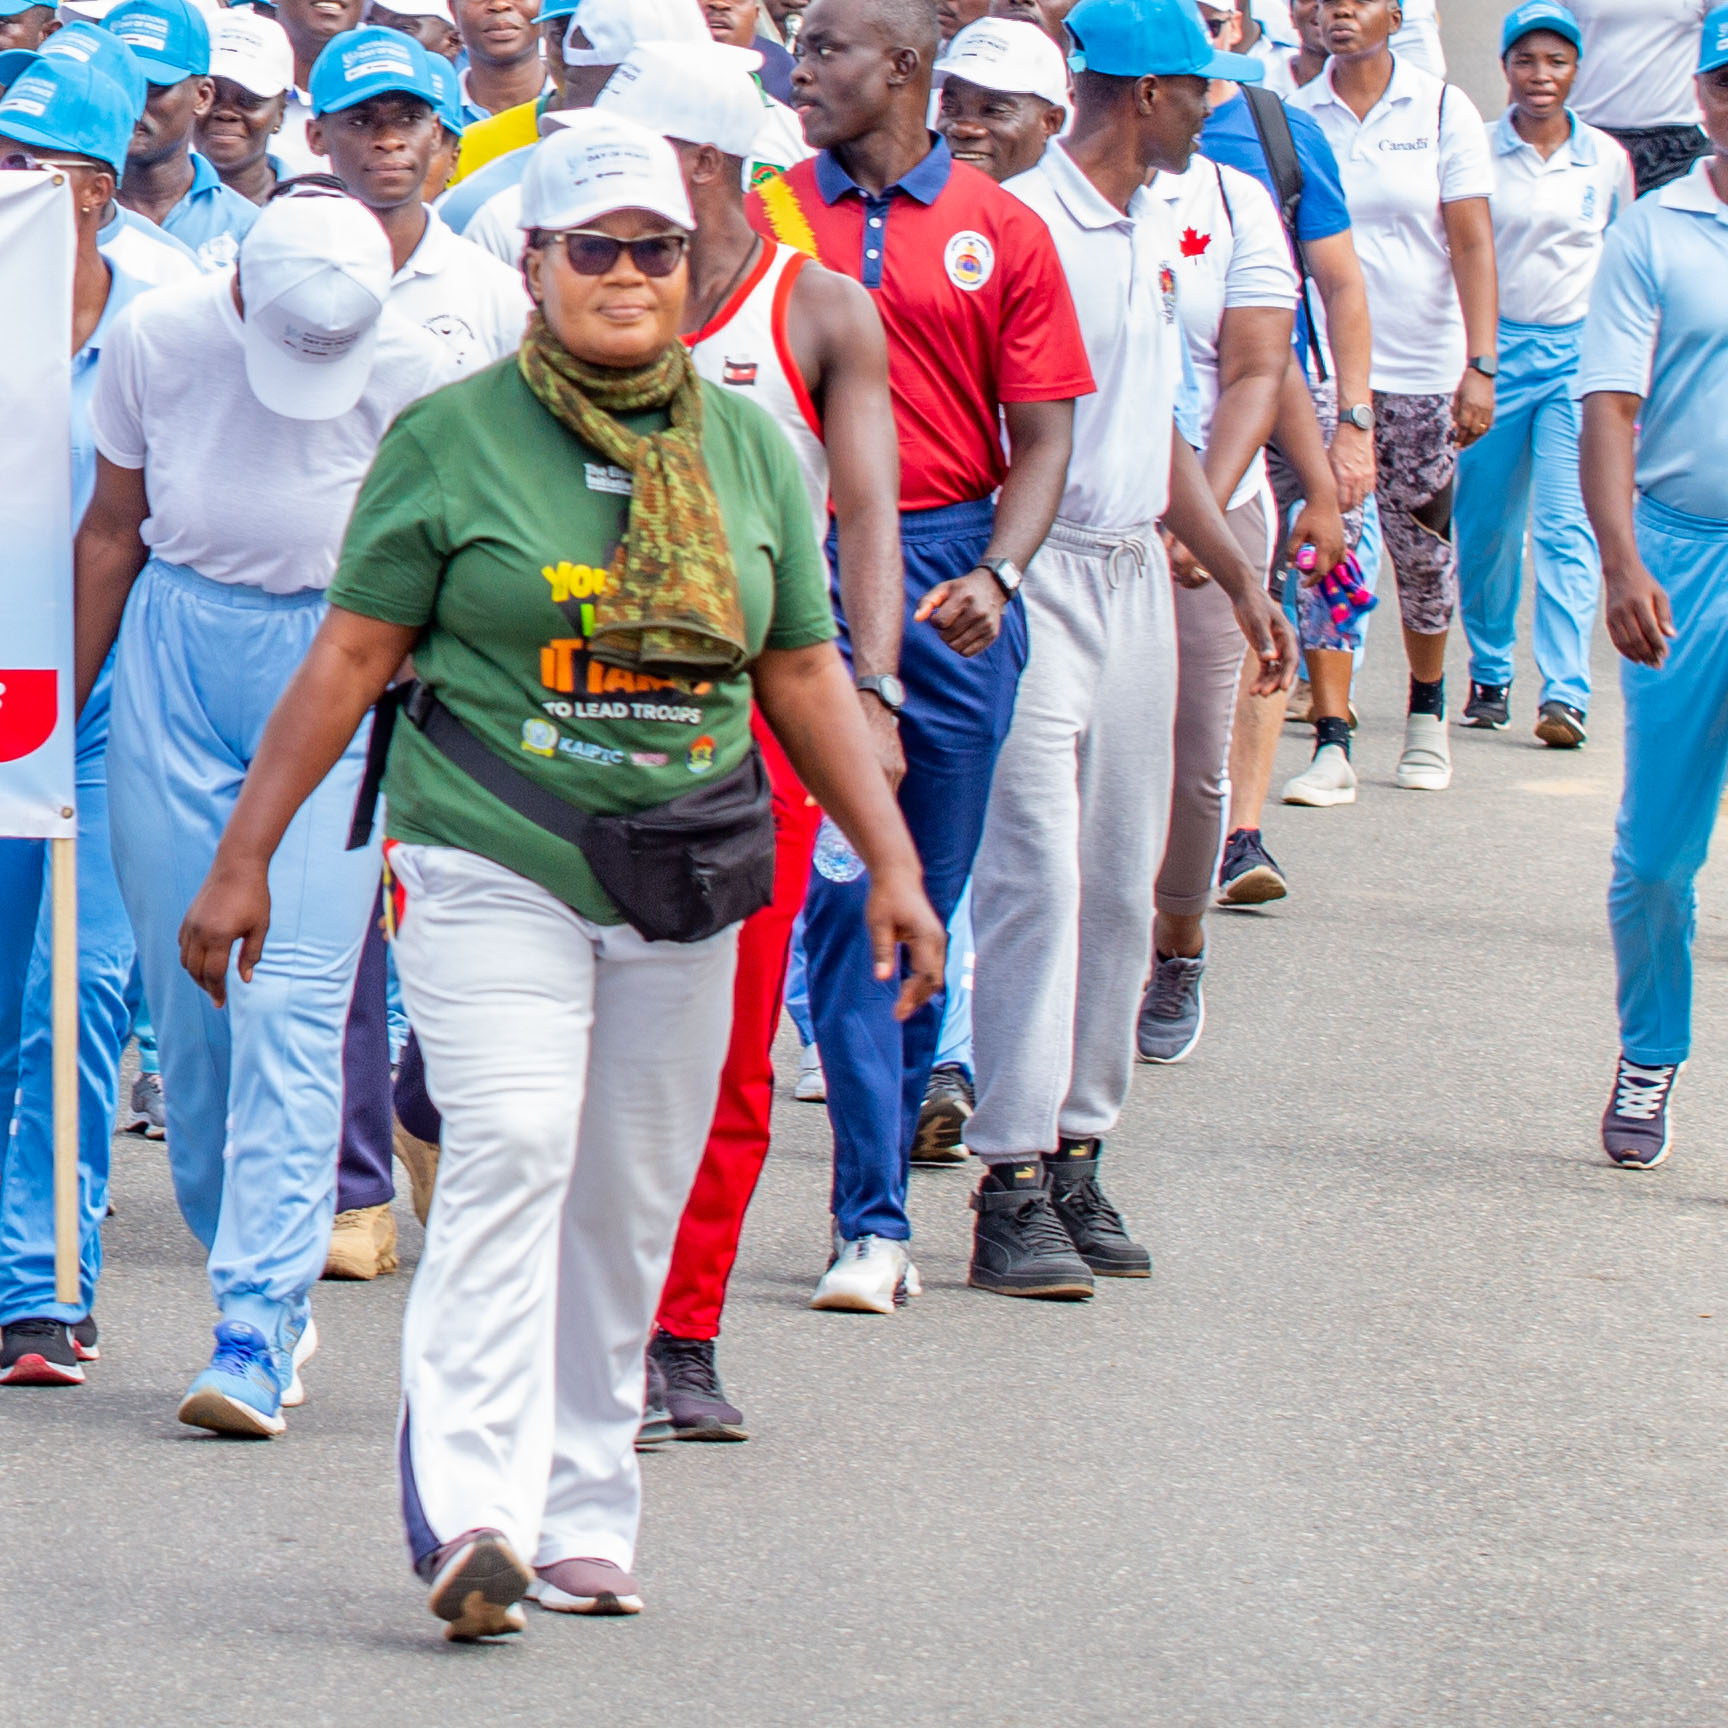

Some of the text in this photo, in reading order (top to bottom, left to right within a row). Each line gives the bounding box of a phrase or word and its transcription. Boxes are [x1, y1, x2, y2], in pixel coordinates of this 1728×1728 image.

[1378, 138, 1428, 151] Canada
[540, 638, 584, 693] IT
[541, 701, 703, 725] TO LEAD TROOPS
